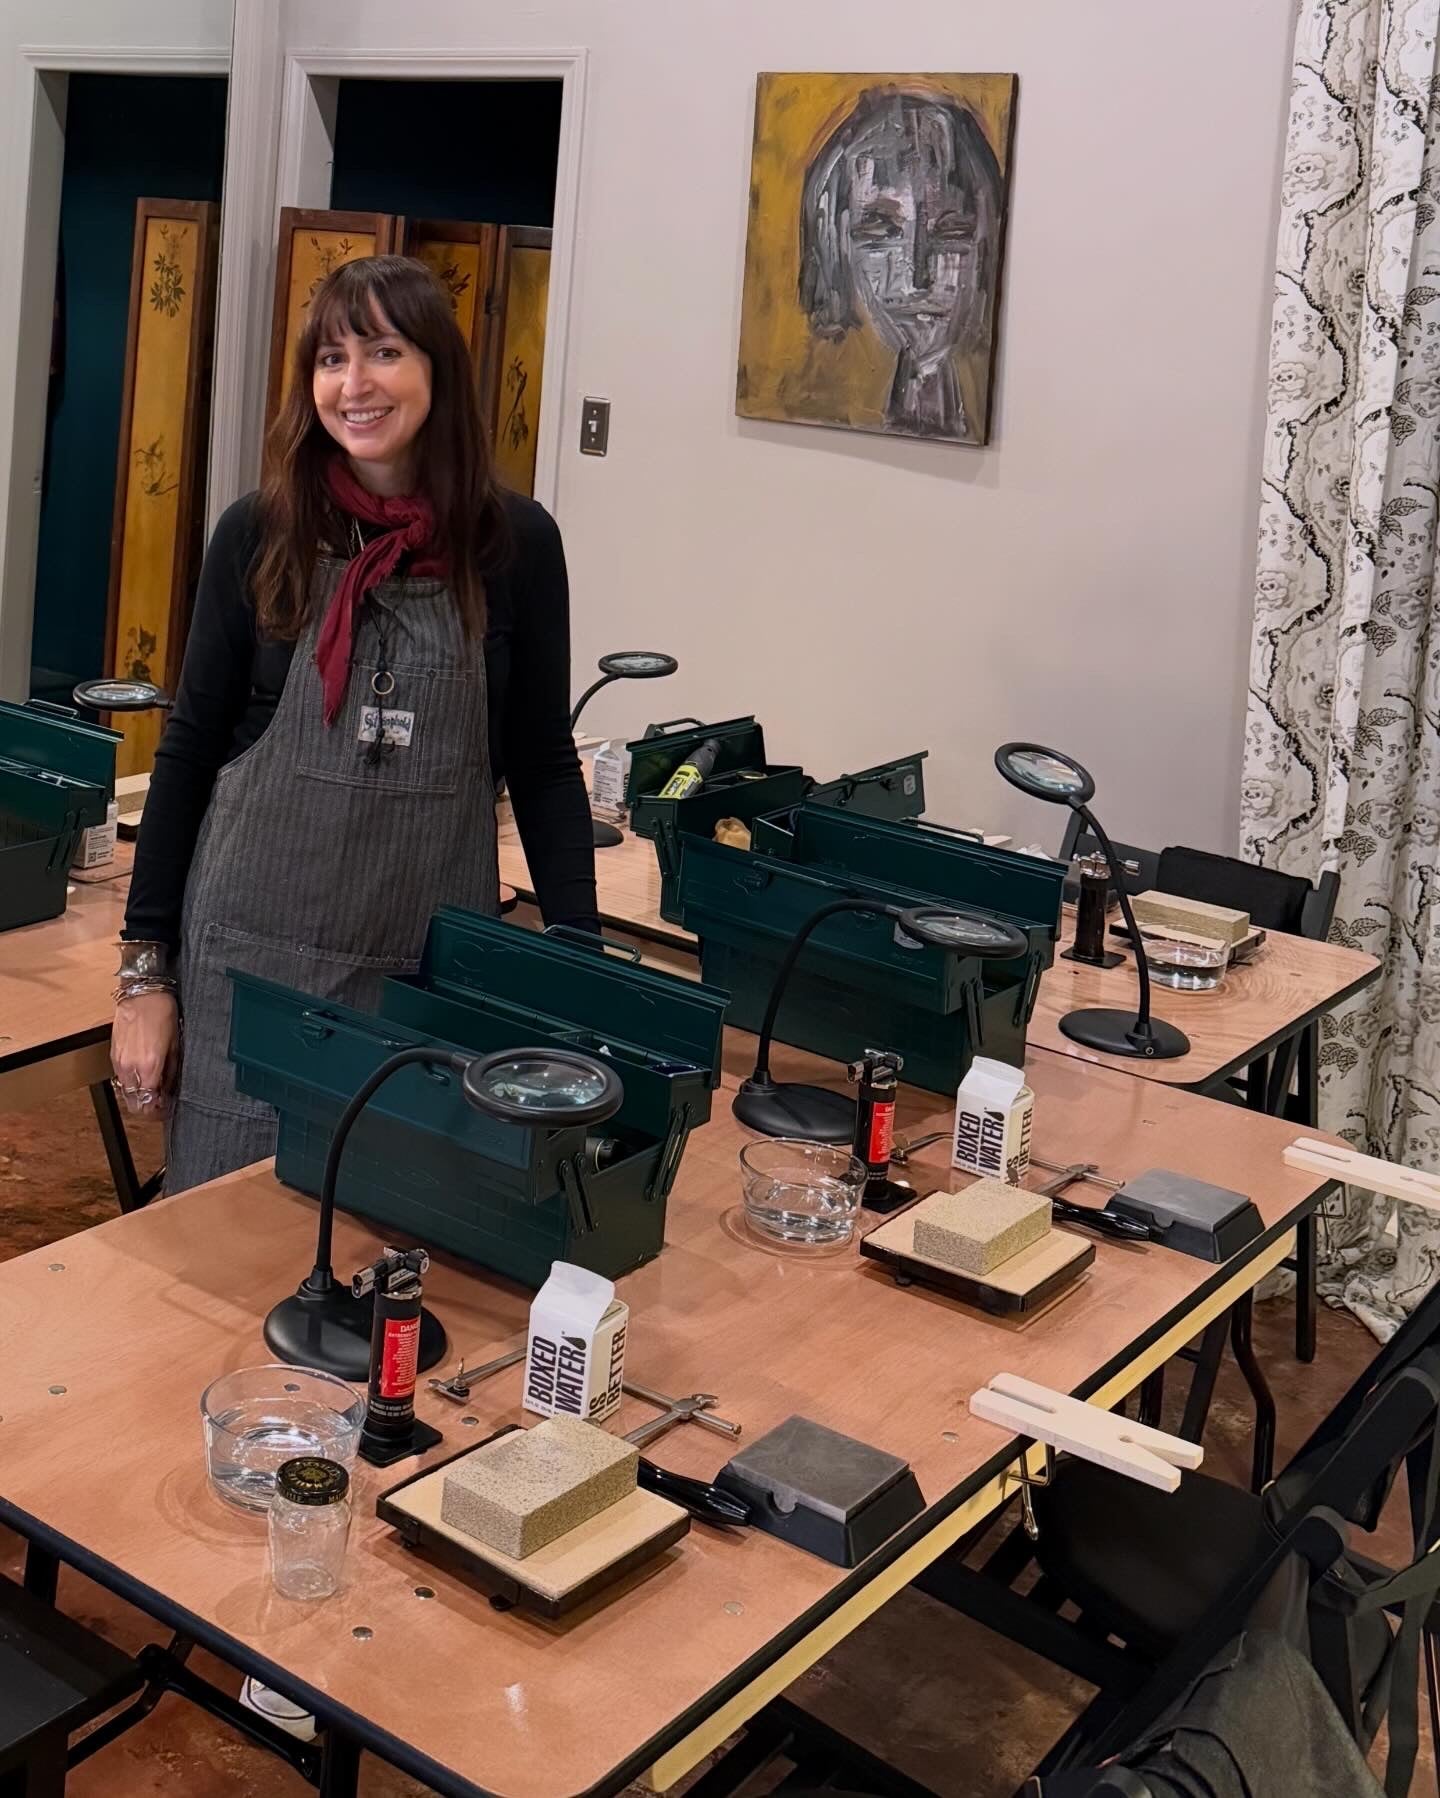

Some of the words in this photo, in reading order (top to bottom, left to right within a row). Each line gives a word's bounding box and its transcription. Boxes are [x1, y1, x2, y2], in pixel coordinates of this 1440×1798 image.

[957, 1111, 981, 1164] BOXED
[979, 1117, 1004, 1171] WATER
[528, 1335, 557, 1405] BOXED
[554, 1343, 586, 1415] WATER
[588, 1390, 608, 1418] IS
